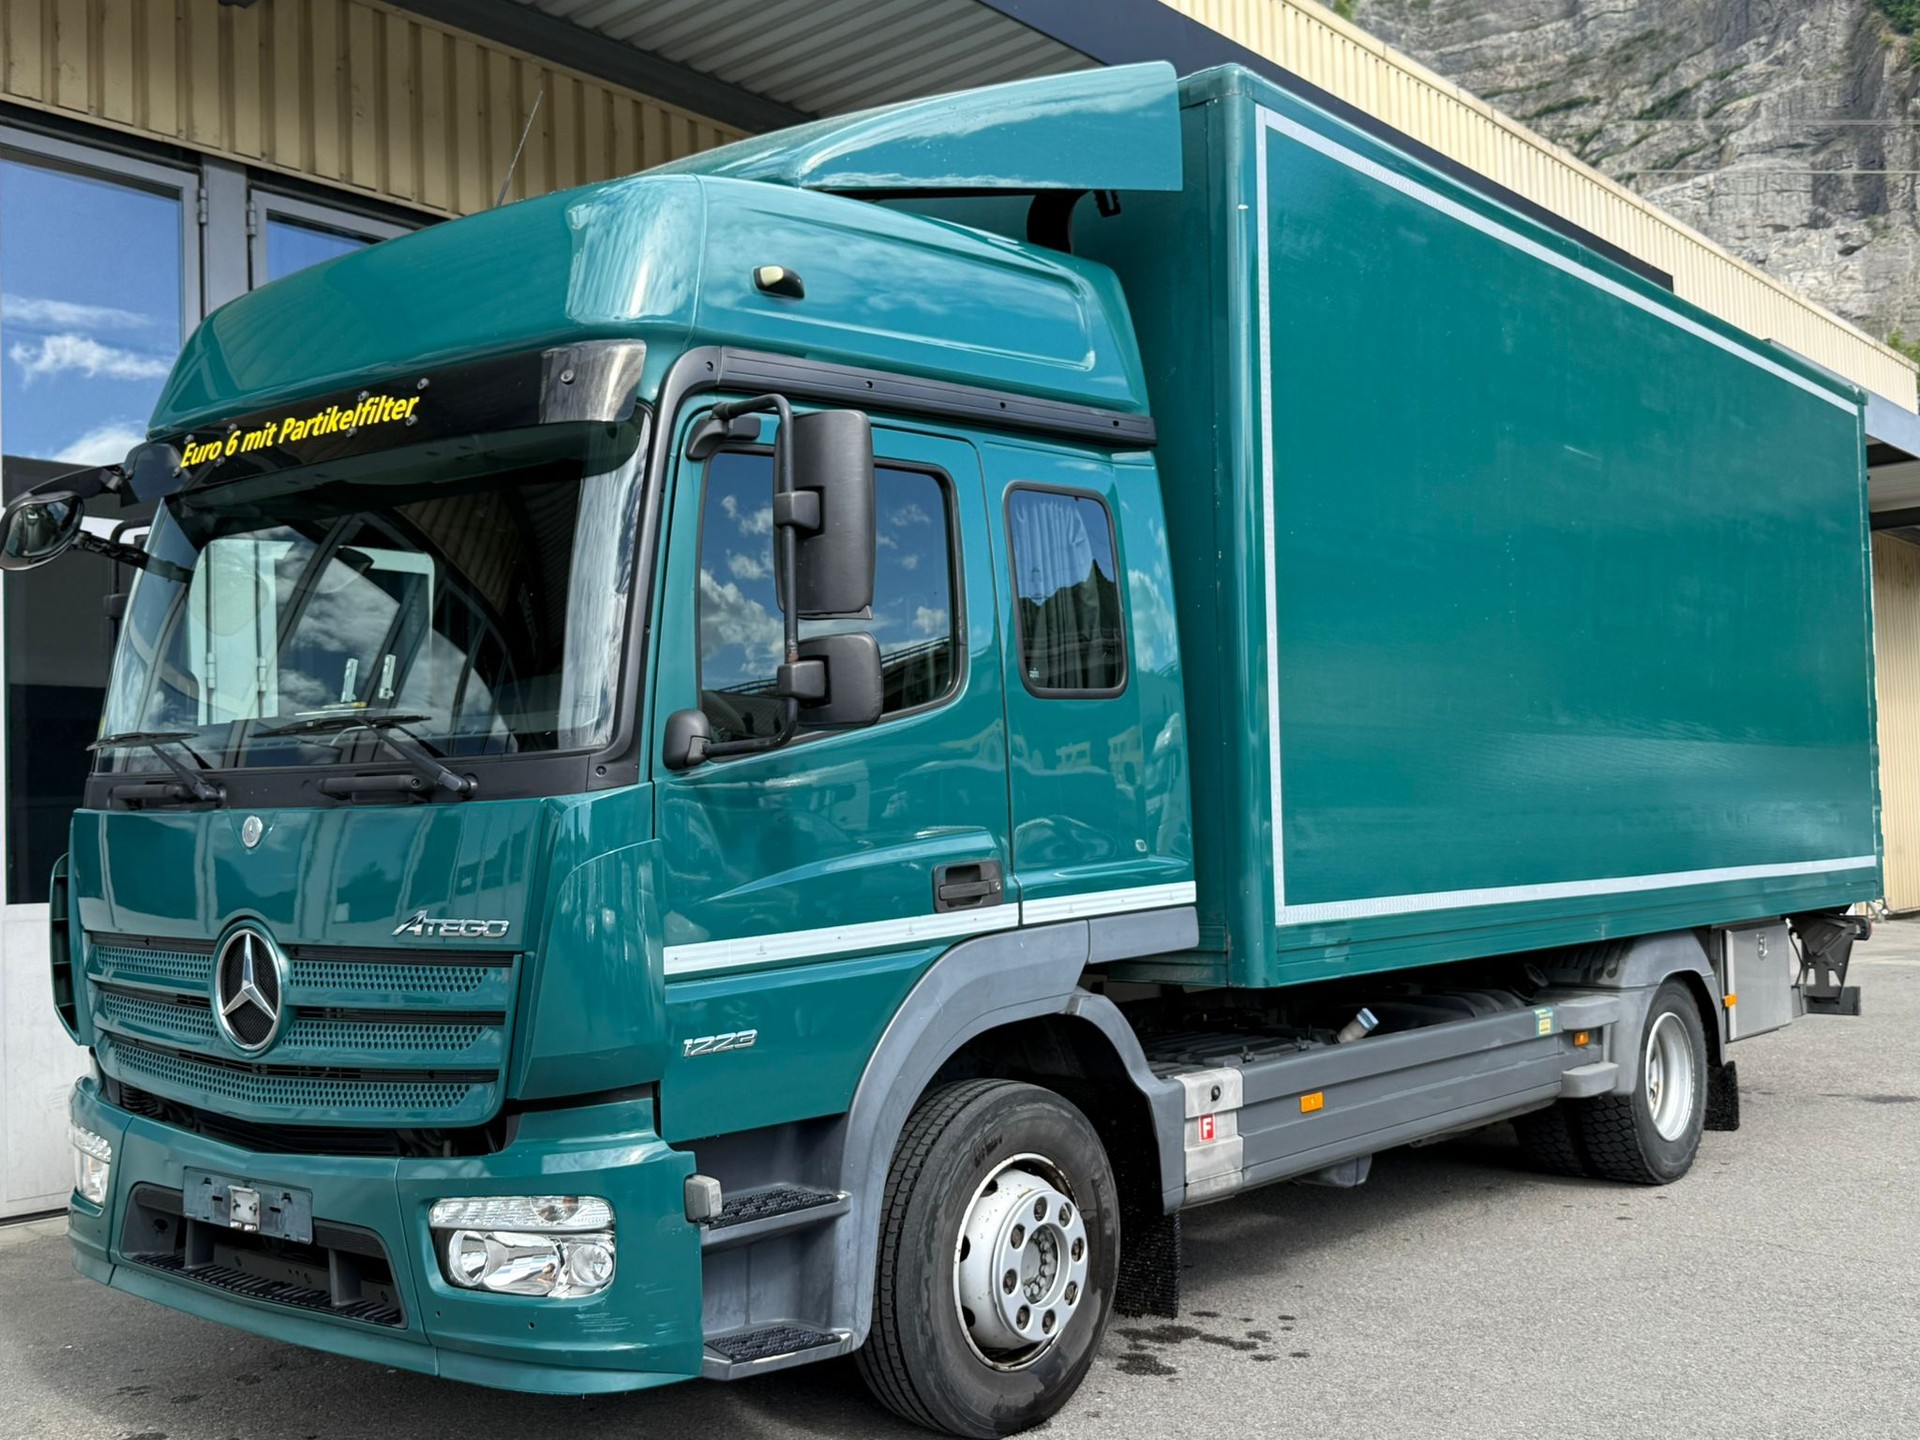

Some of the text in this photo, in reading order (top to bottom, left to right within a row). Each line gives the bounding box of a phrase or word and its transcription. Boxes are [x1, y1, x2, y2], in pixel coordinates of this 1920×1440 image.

[180, 395, 420, 468] Euro 6 mit Partikelfilter
[391, 909, 510, 938] ATEGO
[683, 1029, 758, 1057] 1223
[1202, 1117, 1212, 1139] F
